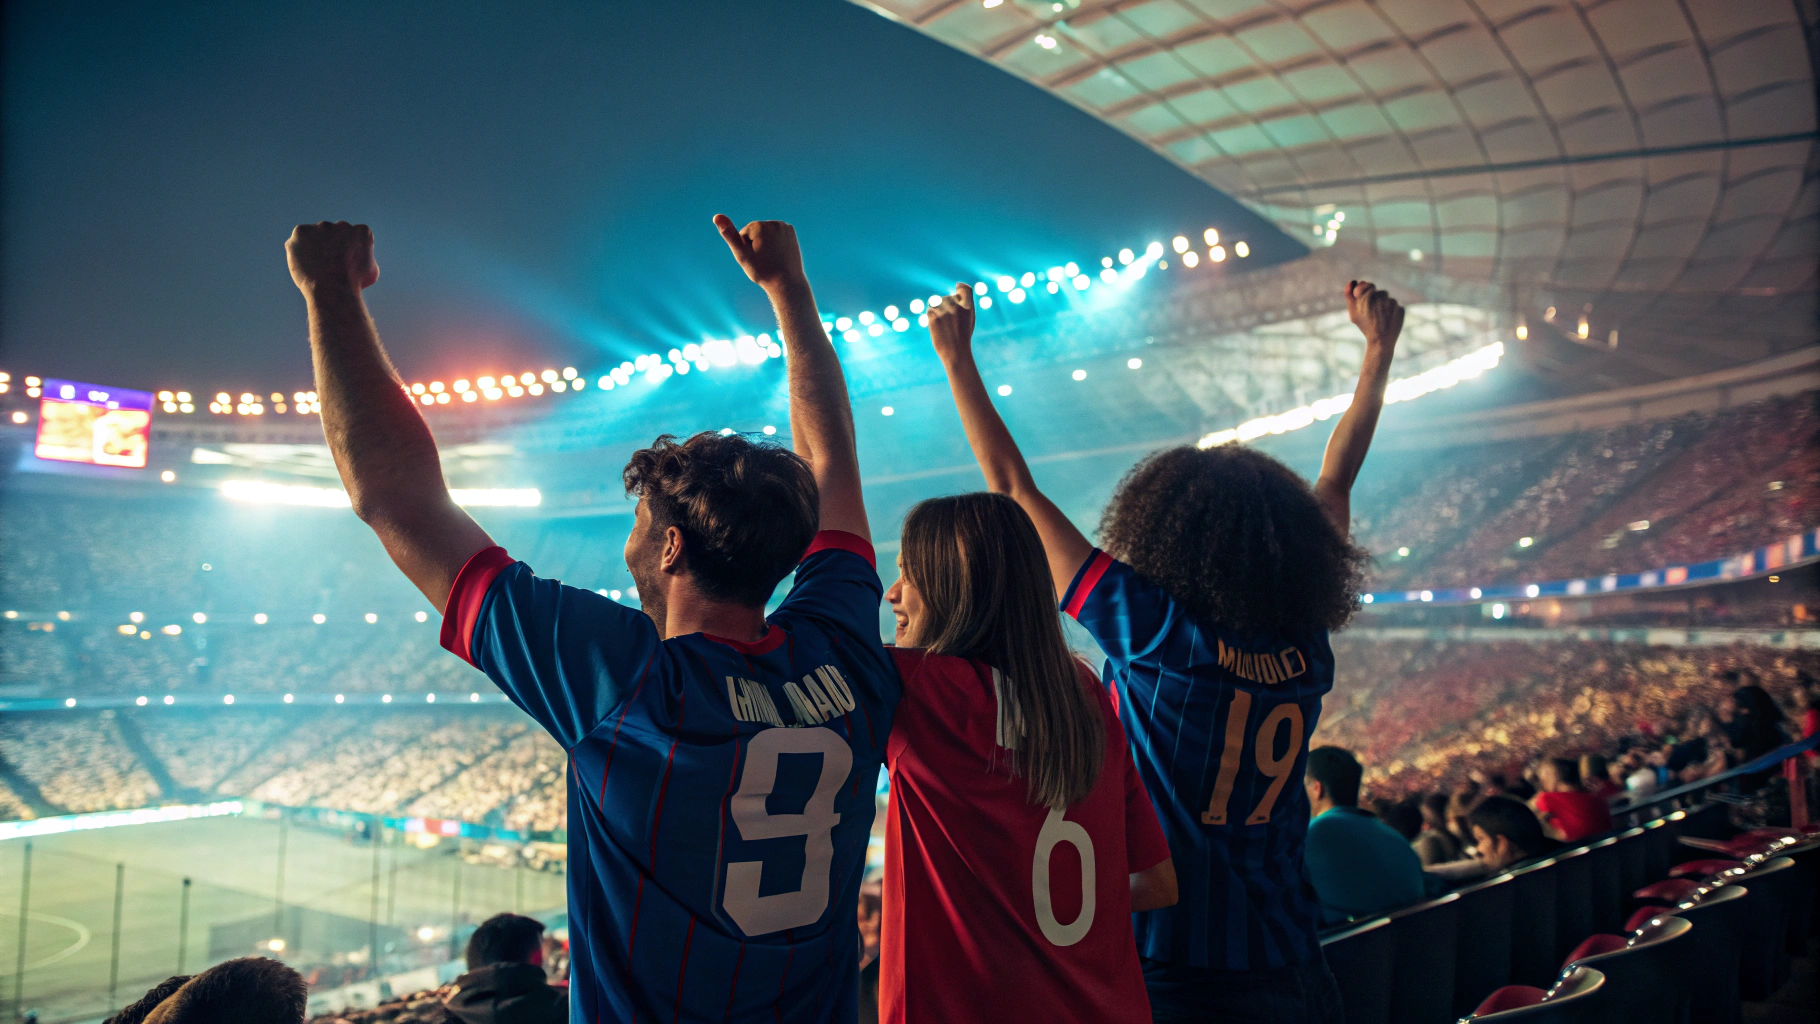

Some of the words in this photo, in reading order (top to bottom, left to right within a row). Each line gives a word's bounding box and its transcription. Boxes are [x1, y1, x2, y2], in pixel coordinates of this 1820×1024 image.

[1201, 688, 1304, 826] 19
[722, 727, 853, 937] 9
[1032, 805, 1096, 947] 6
